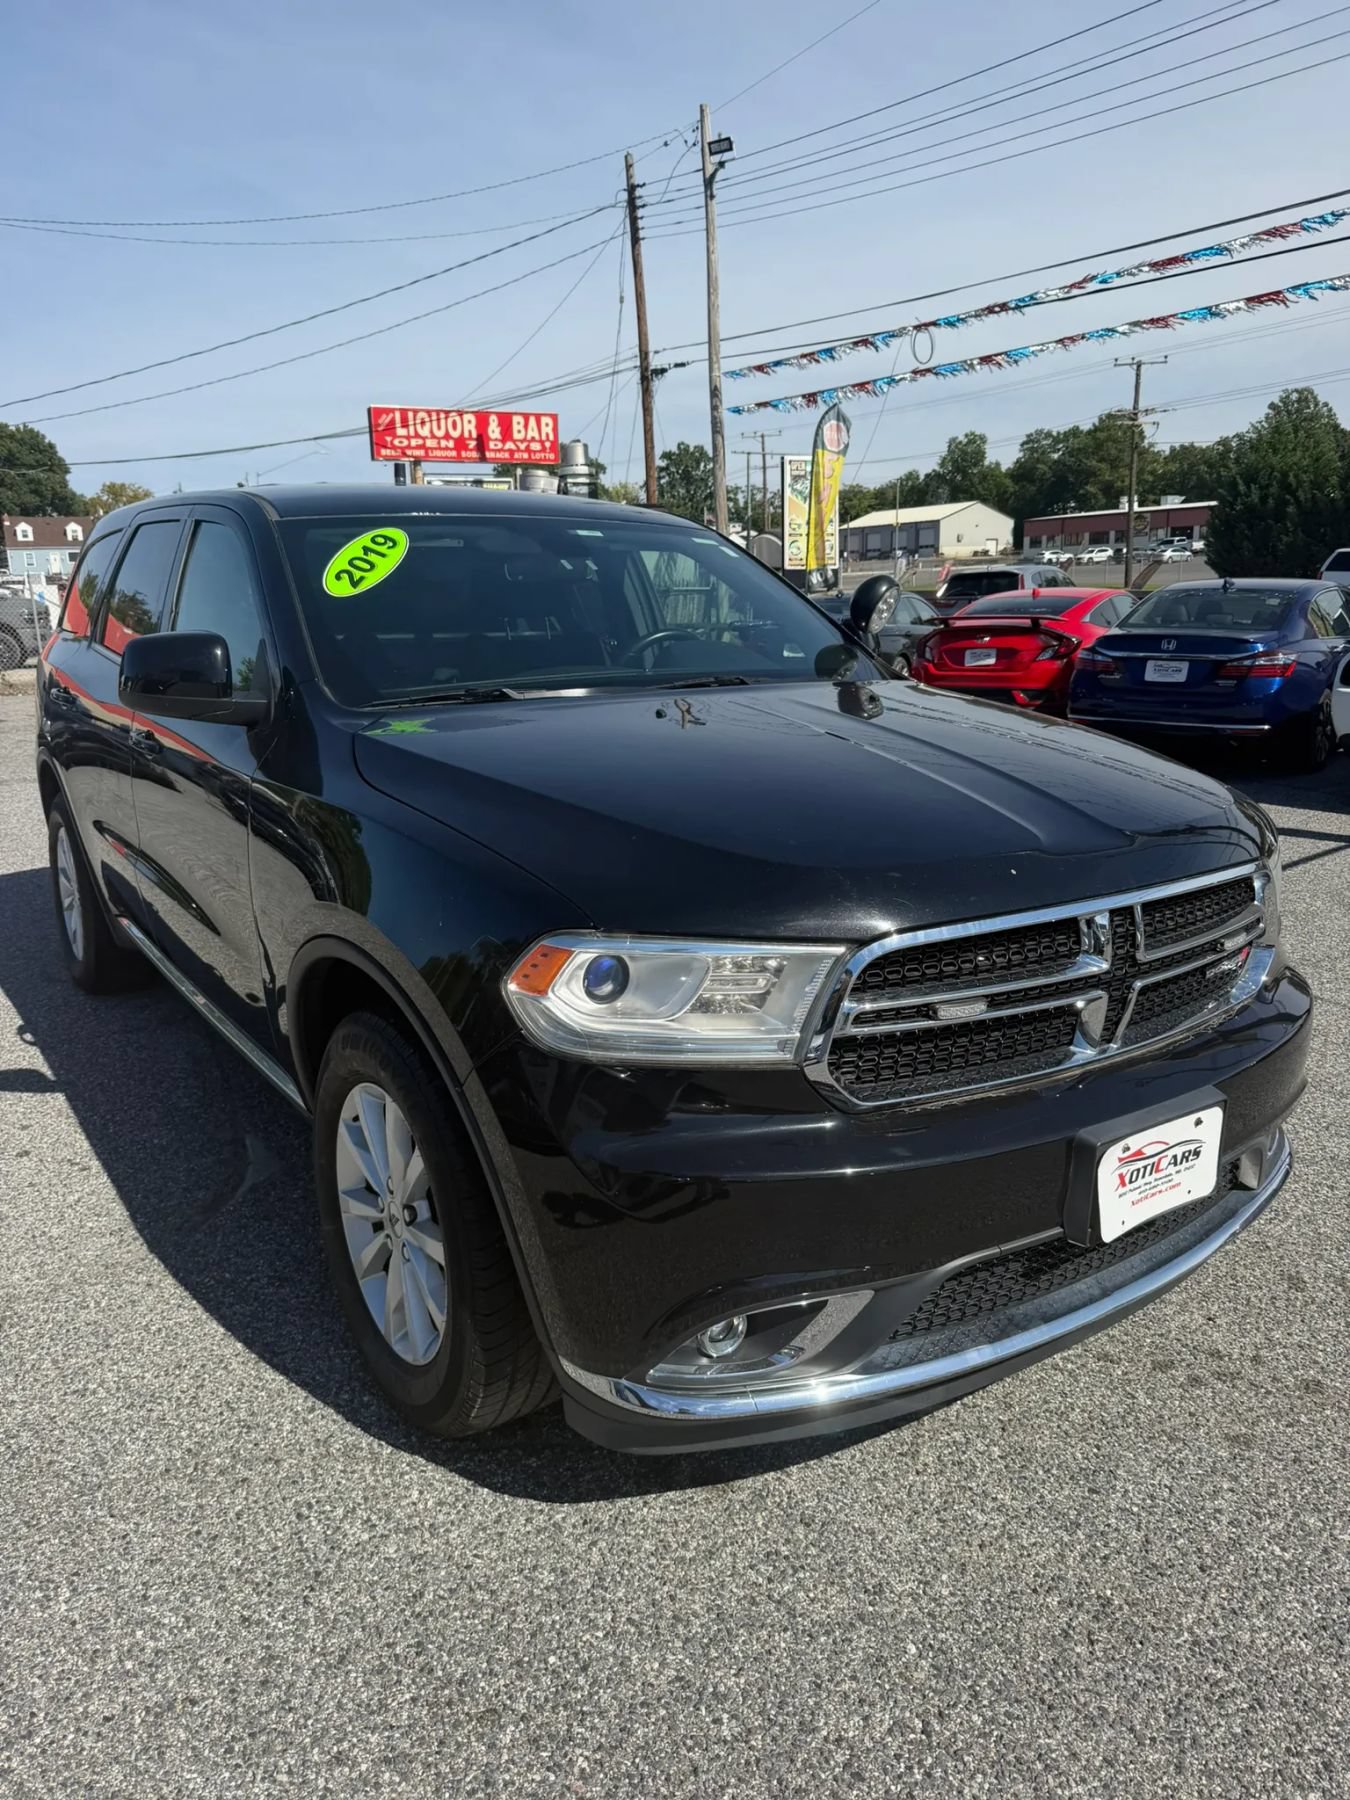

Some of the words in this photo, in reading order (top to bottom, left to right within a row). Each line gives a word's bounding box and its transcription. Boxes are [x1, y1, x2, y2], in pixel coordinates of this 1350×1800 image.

[394, 410, 477, 439] LIQUOR
[487, 414, 502, 441] &
[511, 415, 555, 442] BAR
[393, 437, 455, 449] OPEN
[465, 440, 477, 449] 7
[404, 449, 426, 457] WINE
[428, 450, 458, 458] LIQUOR
[485, 451, 511, 459] SNACK
[513, 452, 529, 460] ATM
[530, 452, 556, 460] LOTTO
[334, 533, 398, 590] 2019
[1114, 1145, 1204, 1193] XOTICARS
